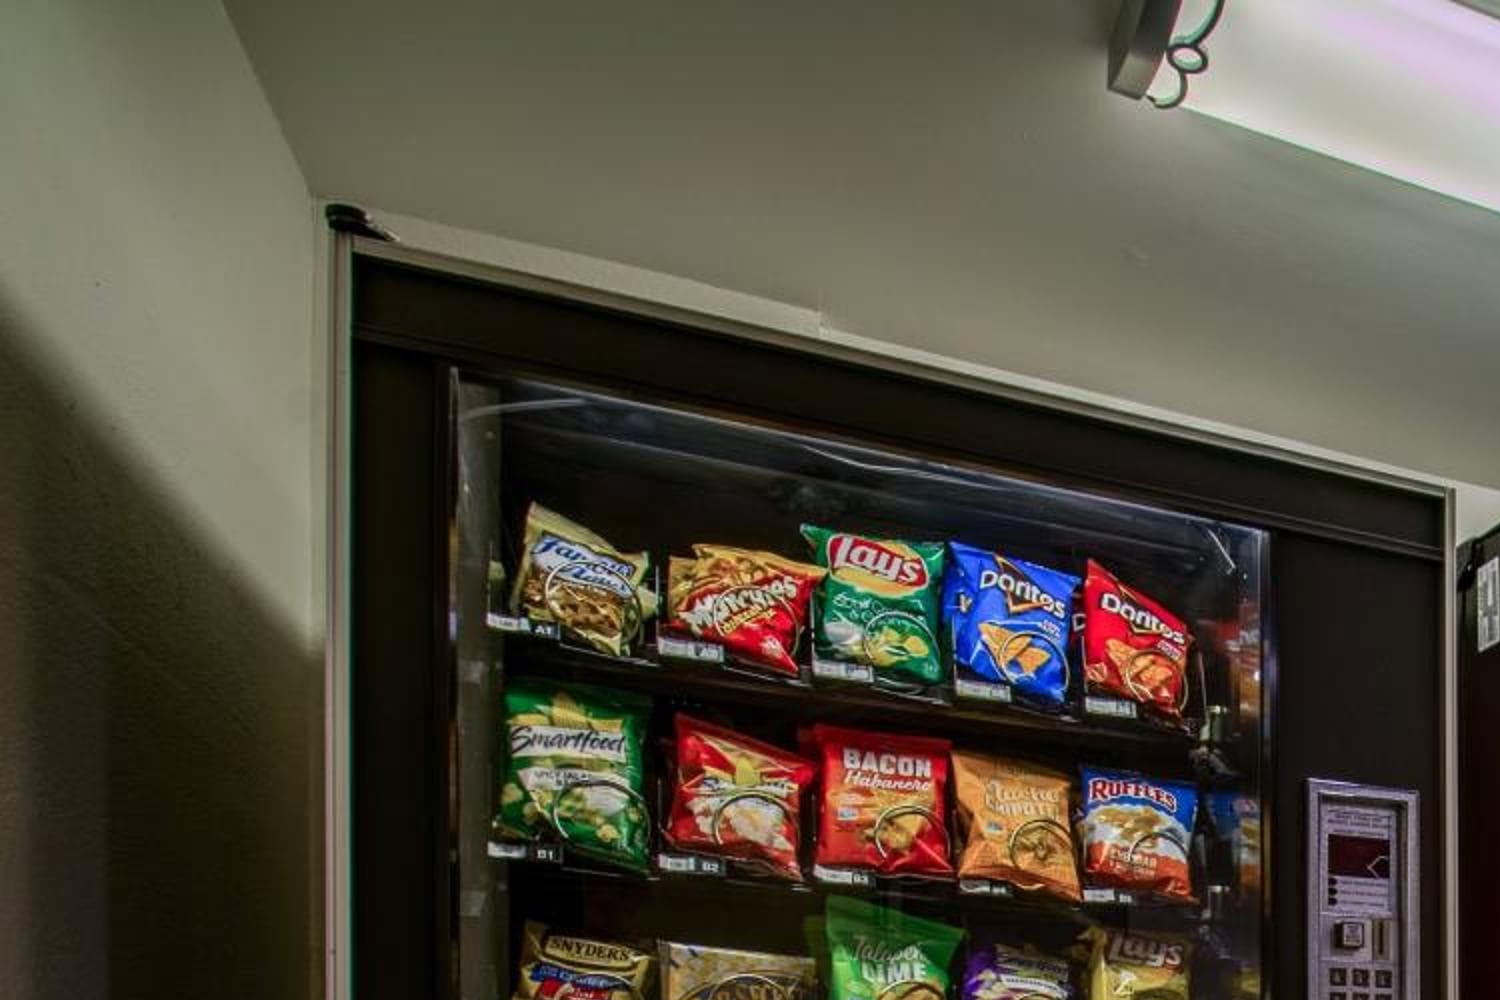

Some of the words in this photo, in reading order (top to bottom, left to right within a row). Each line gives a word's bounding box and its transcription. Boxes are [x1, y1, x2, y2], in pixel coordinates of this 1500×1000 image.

[980, 569, 1066, 618] Doritos
[1101, 593, 1186, 646] Doritos
[510, 725, 626, 752] Smartfood
[843, 747, 931, 776] BACON
[844, 769, 931, 792] Habanero
